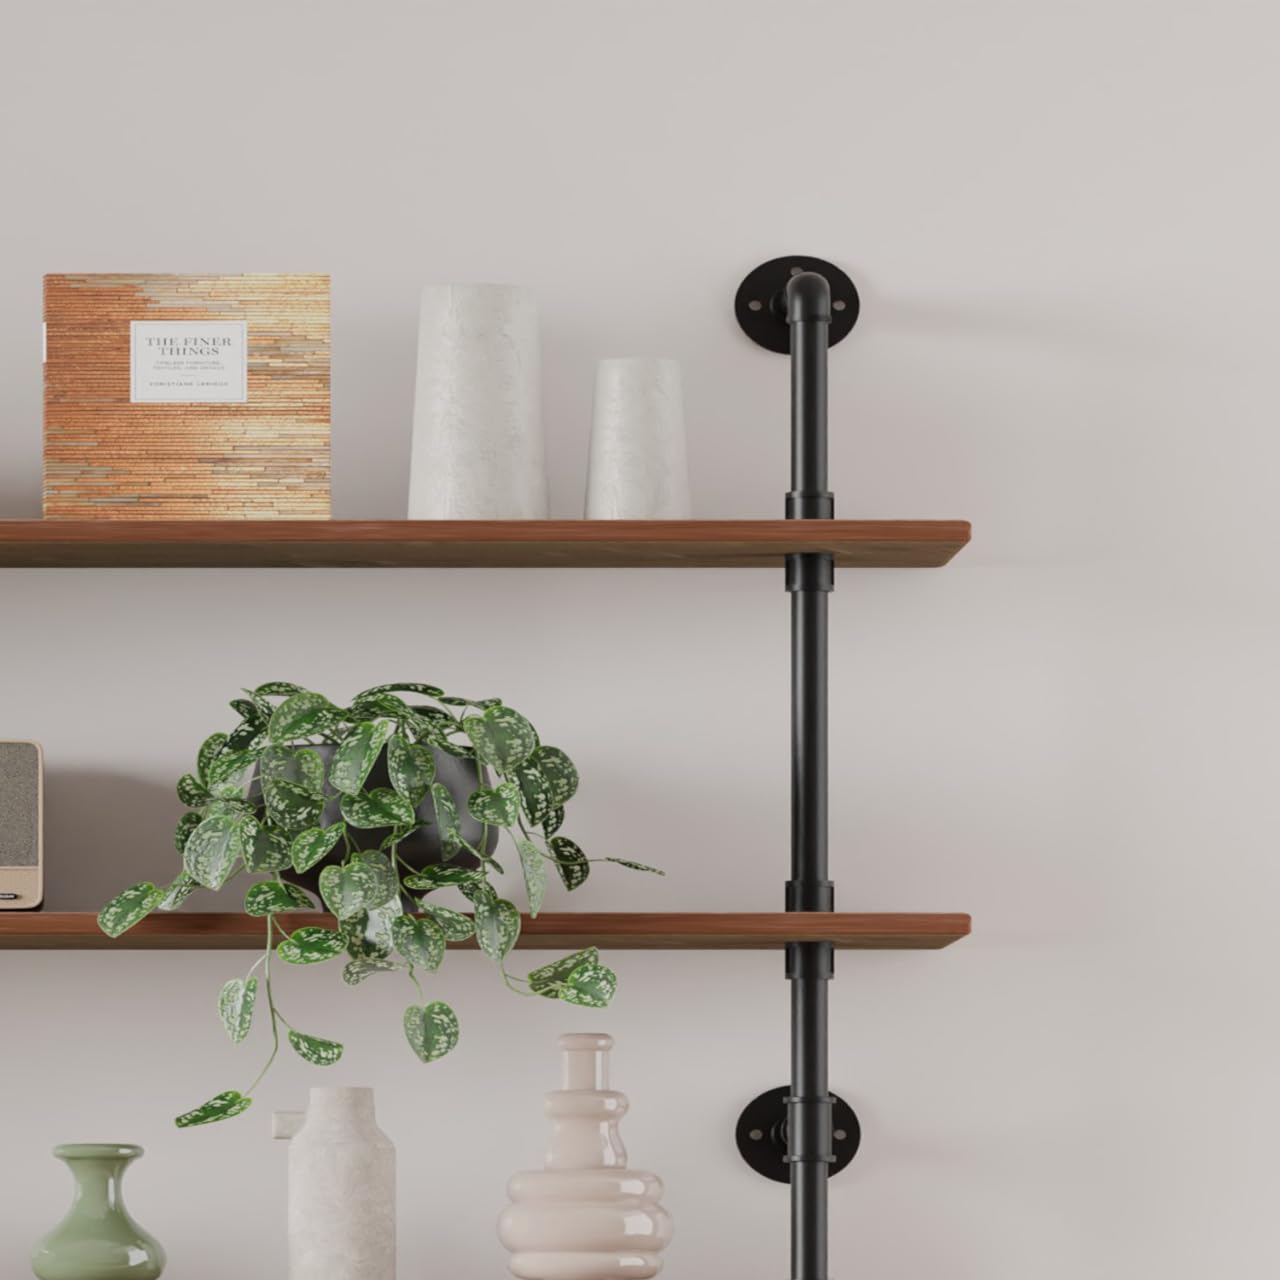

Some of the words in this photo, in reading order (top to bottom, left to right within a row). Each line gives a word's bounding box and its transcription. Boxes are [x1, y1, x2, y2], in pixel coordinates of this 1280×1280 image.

[146, 337, 178, 346] THE
[183, 337, 232, 346] FINER
[159, 347, 220, 356] THINGS
